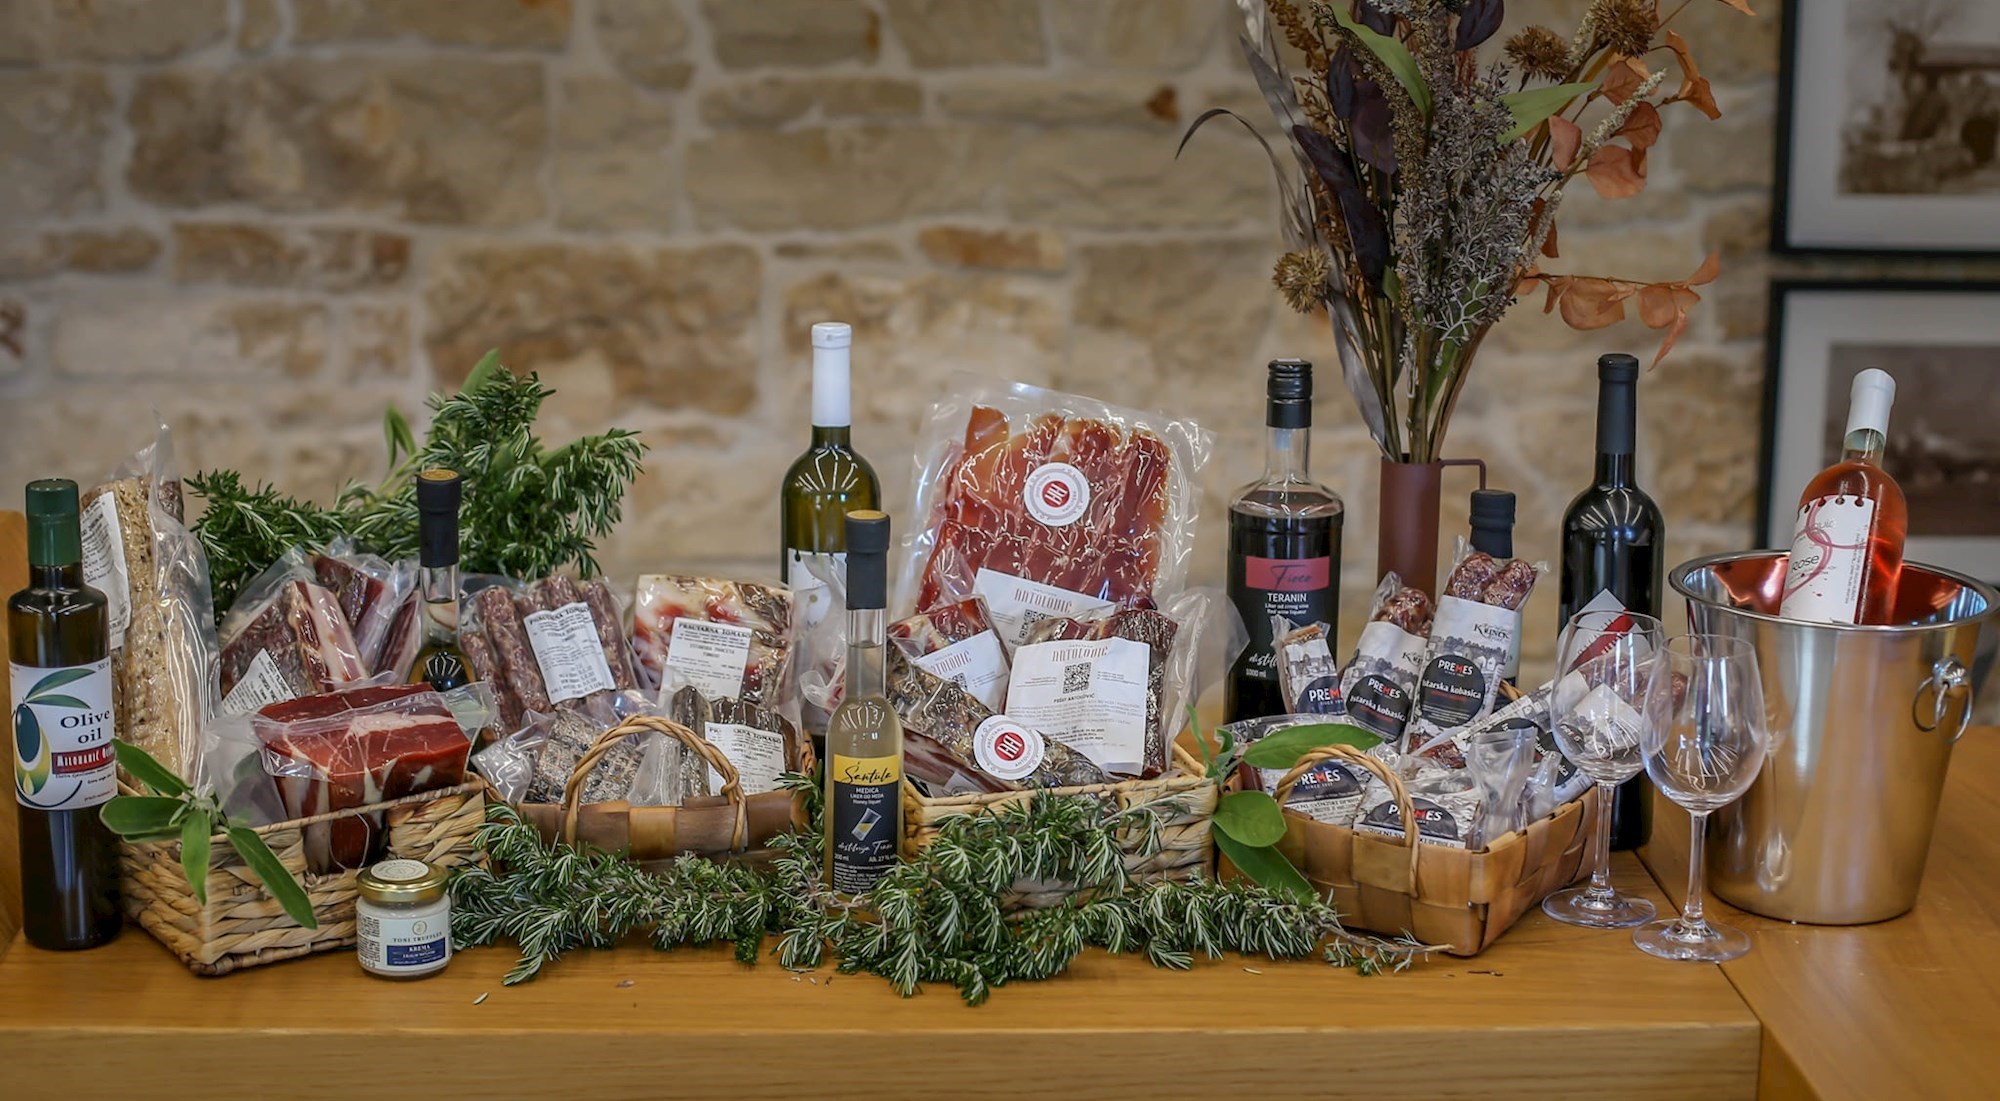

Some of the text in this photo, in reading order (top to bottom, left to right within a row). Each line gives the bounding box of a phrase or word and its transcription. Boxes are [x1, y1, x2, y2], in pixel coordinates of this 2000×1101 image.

[1267, 592, 1307, 602] TERANIN
[1438, 660, 1473, 676] PREMES
[1308, 688, 1341, 702] PREM
[1368, 678, 1400, 698] PREMES
[1450, 685, 1481, 699] kobasica
[60, 710, 110, 729] Olive
[78, 728, 102, 744] oil
